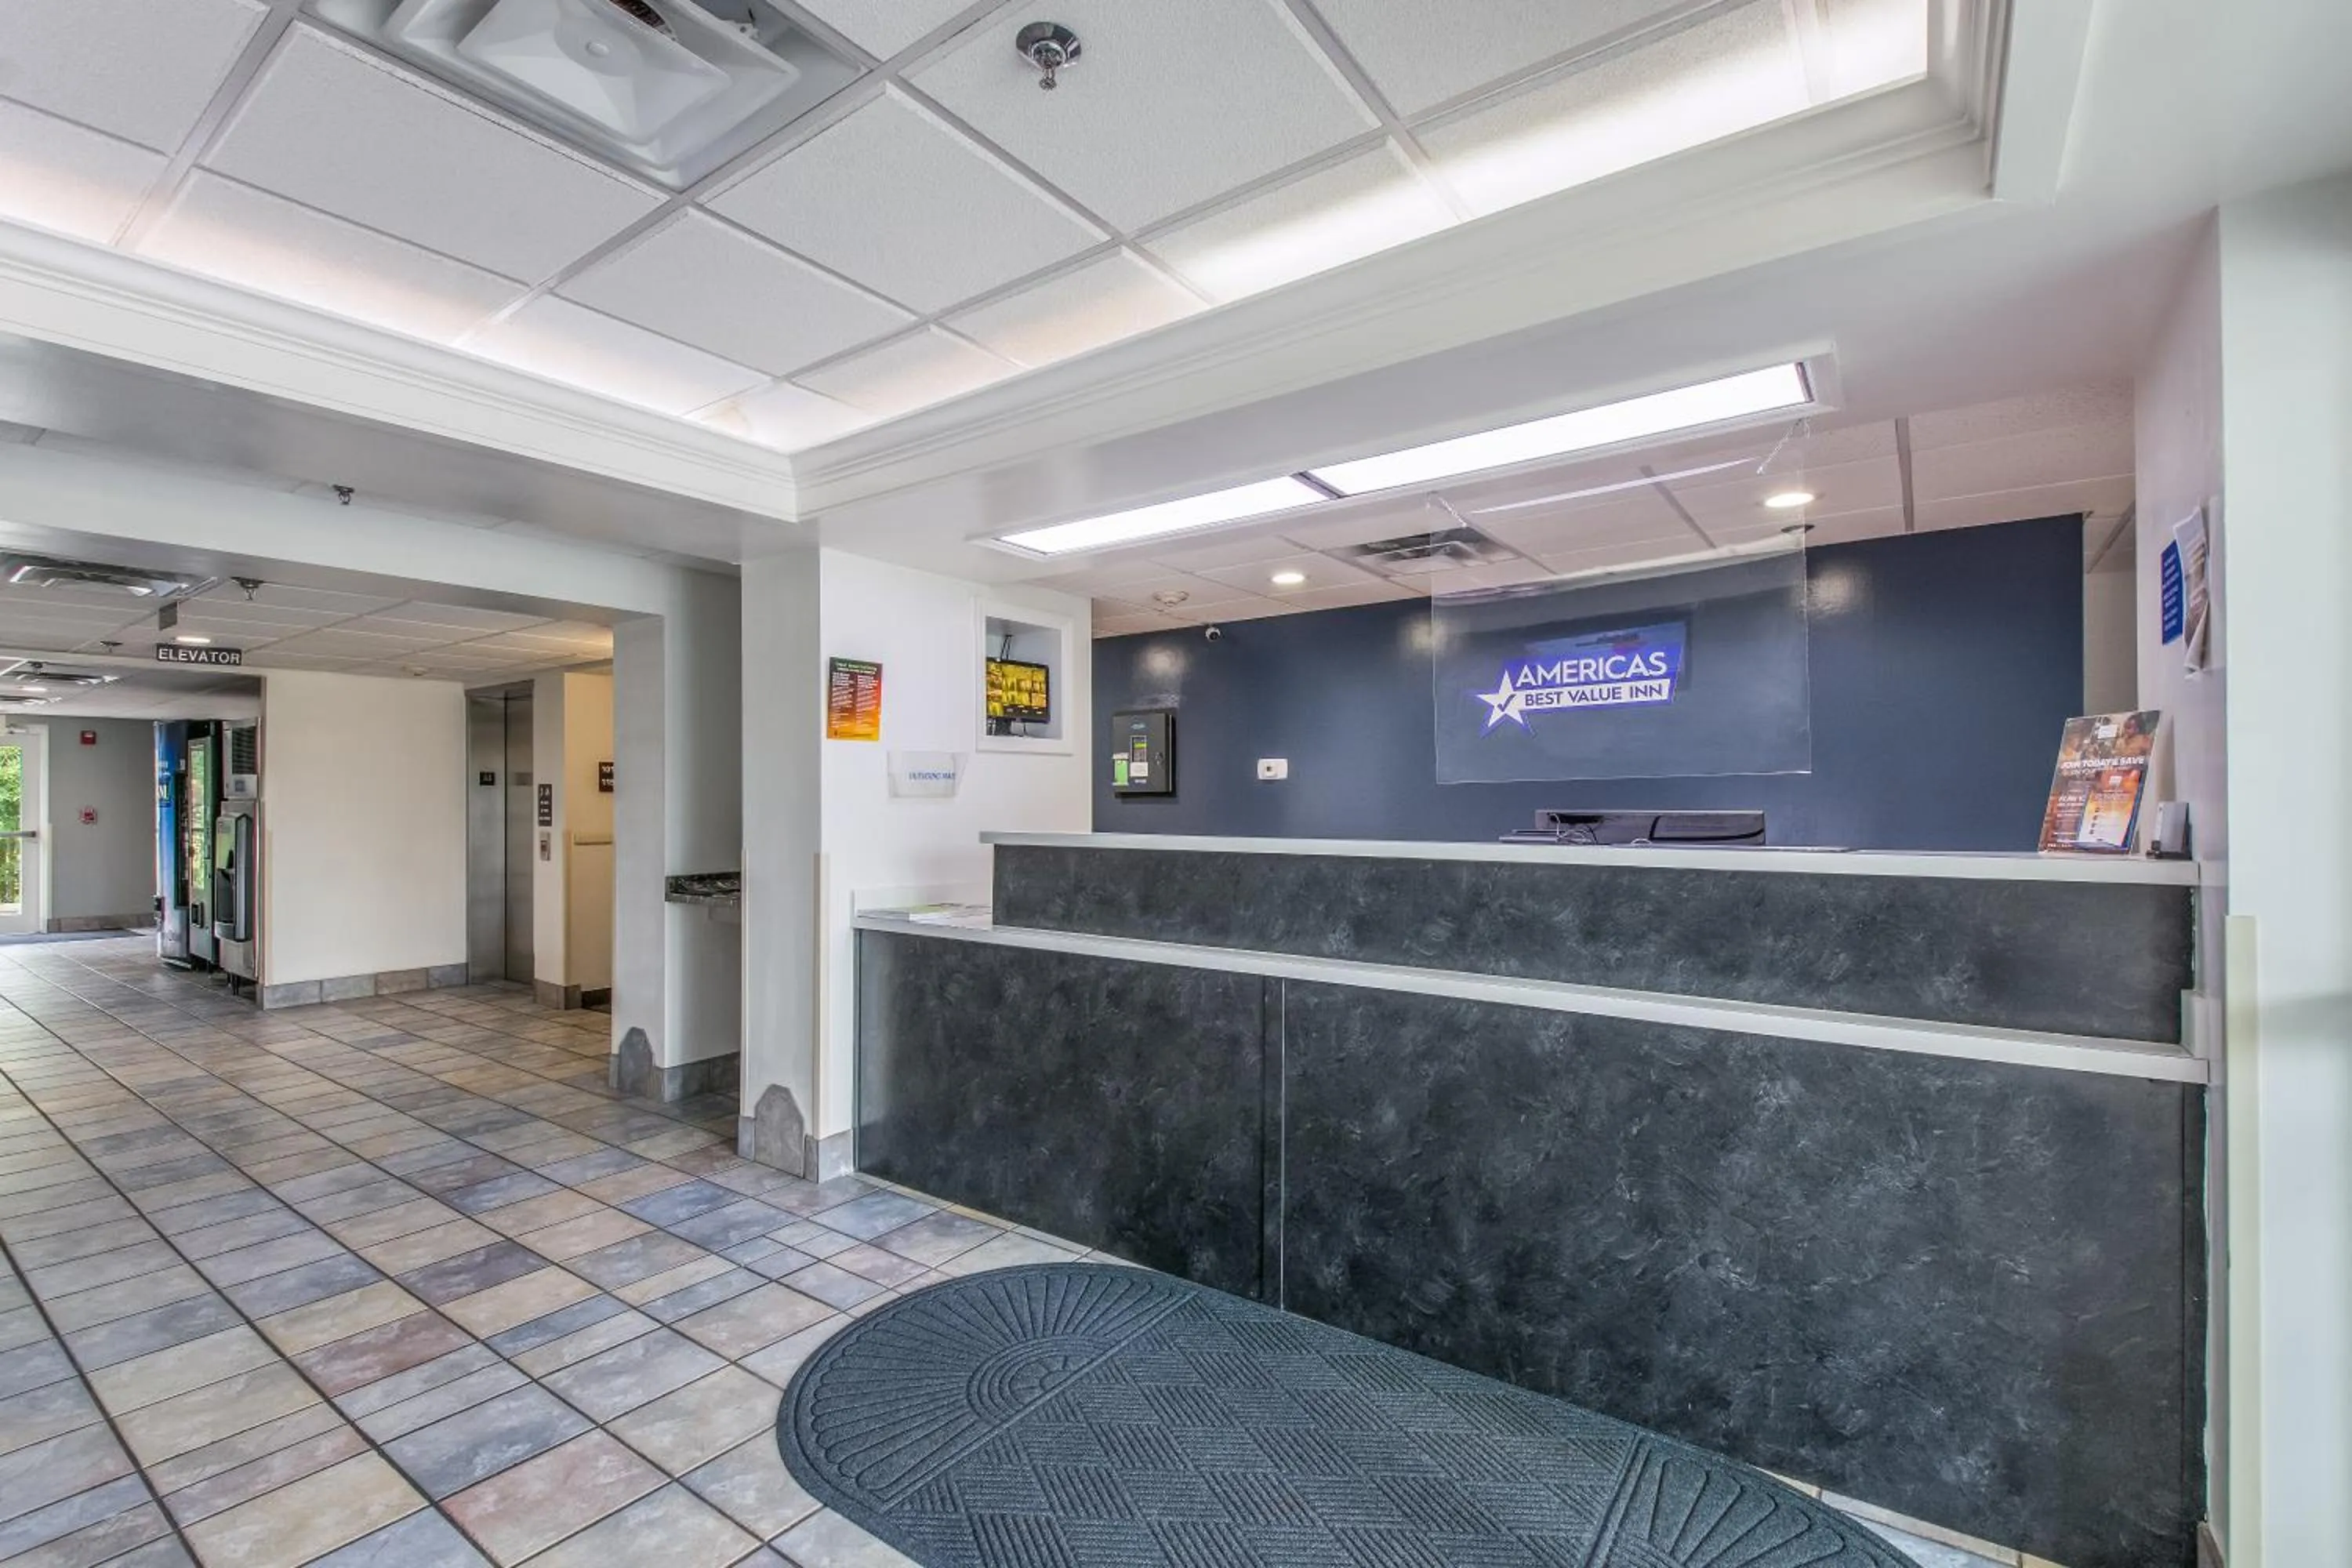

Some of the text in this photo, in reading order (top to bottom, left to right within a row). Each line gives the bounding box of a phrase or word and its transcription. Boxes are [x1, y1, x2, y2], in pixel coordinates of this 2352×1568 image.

[158, 648, 240, 664] ELEVATOR
[1516, 652, 1668, 687] AMERICAS
[1525, 683, 1662, 706] BEST VALUE INN
